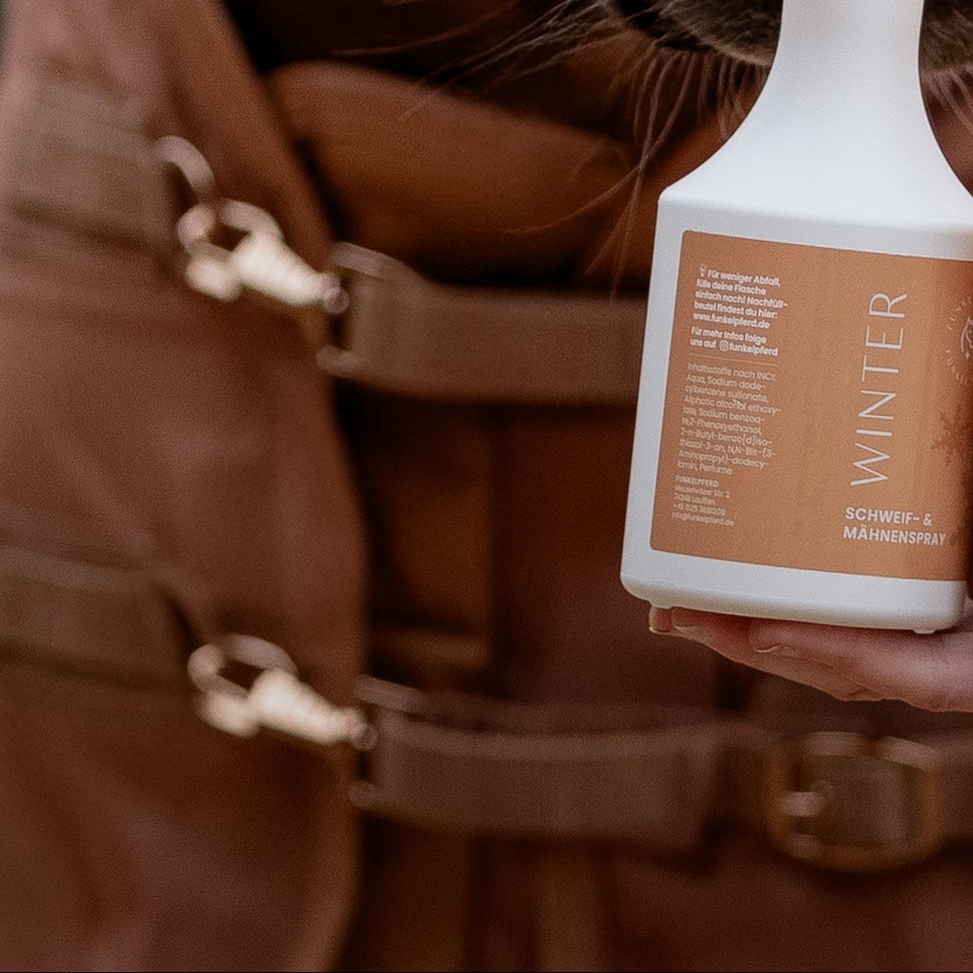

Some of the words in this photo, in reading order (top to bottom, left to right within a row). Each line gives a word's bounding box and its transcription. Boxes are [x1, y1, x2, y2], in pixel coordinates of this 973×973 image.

[720, 272, 752, 283] weniger
[712, 281, 733, 291] deine
[695, 290, 722, 301] einfach
[745, 306, 757, 316] du
[758, 309, 778, 319] hier:
[702, 328, 723, 338] mehr
[745, 333, 767, 345] folge
[707, 376, 737, 387] Sodium
[850, 292, 908, 487] WINTER
[845, 505, 920, 525] SCHWEIF-
[923, 513, 934, 527] &
[843, 524, 947, 547] MÄHNENSPRAY
